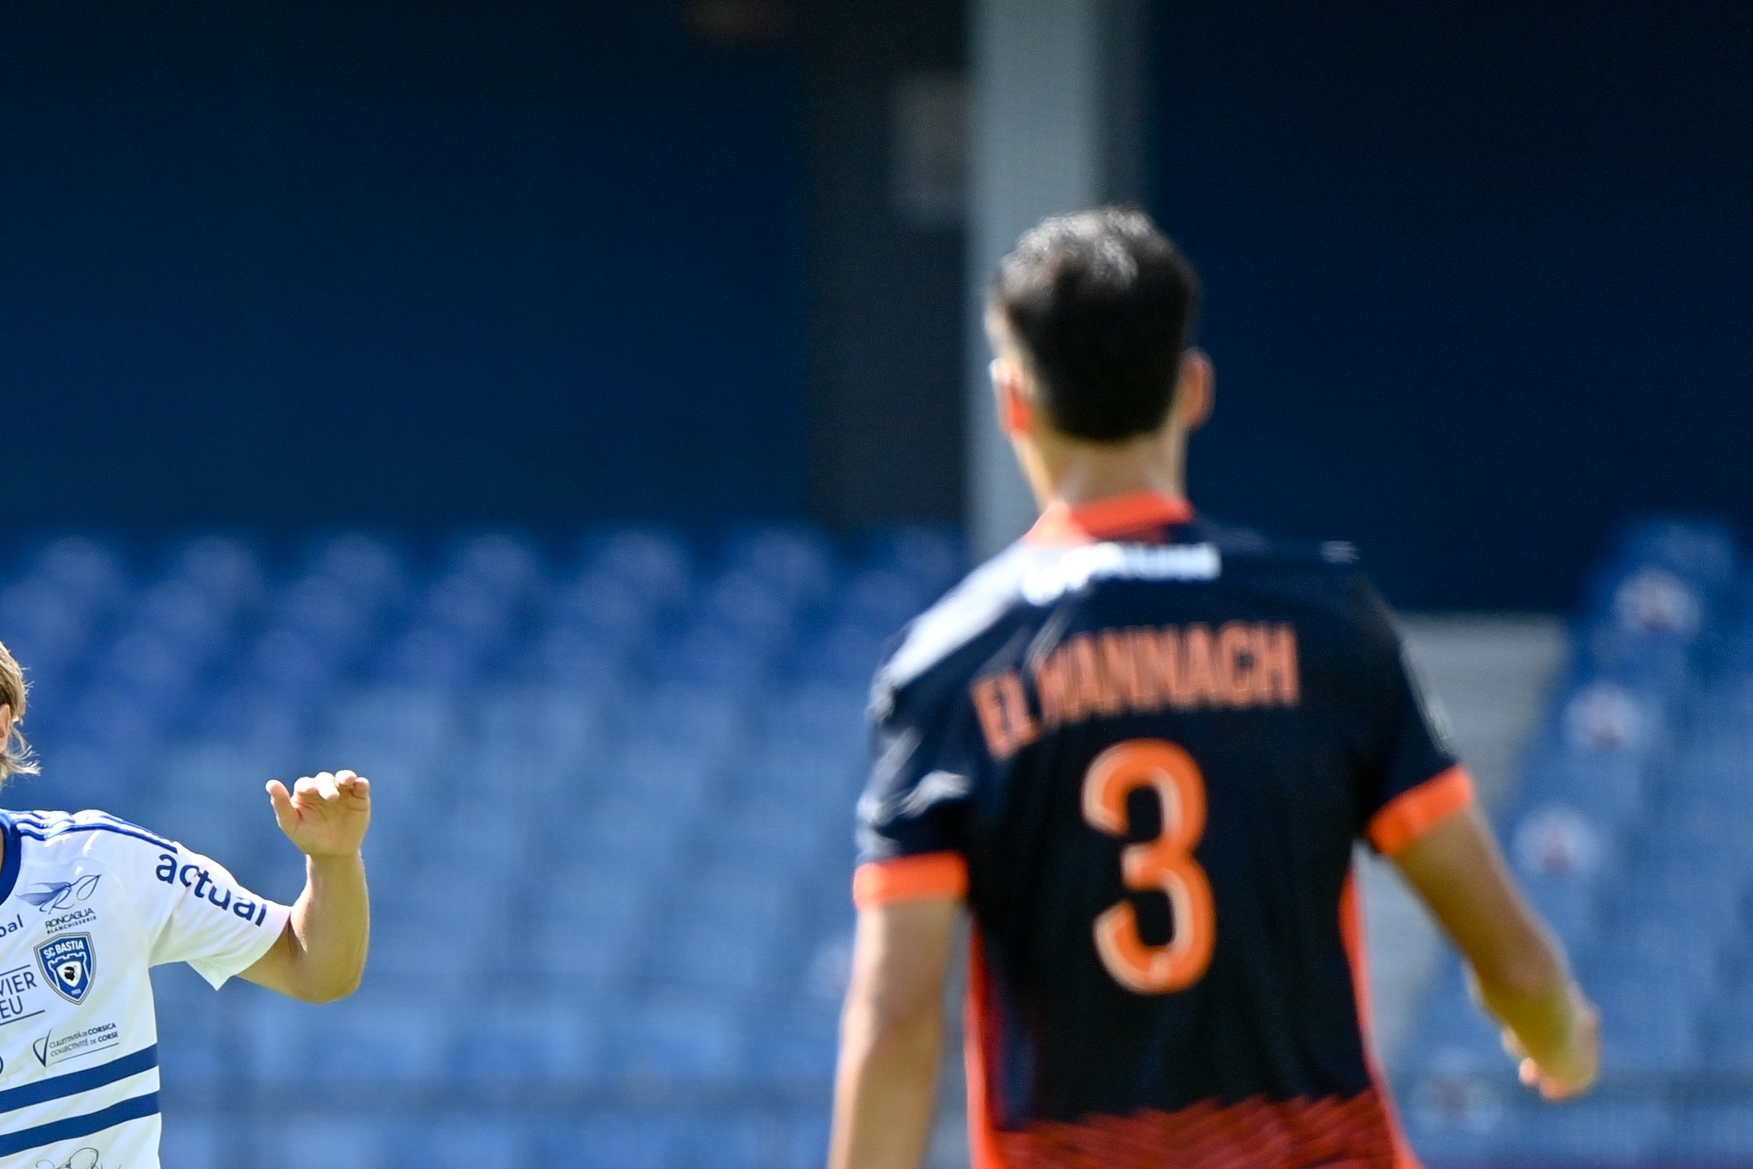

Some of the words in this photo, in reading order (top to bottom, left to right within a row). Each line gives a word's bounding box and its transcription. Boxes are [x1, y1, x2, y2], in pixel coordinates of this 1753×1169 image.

[1083, 739, 1216, 995] 3
[156, 853, 267, 927] actual
[45, 907, 95, 929] RONCAGLIA
[43, 946, 56, 959] SC
[54, 940, 84, 954] BASTIA
[87, 1022, 117, 1036] CORSICA
[97, 1031, 118, 1043] CORSE
